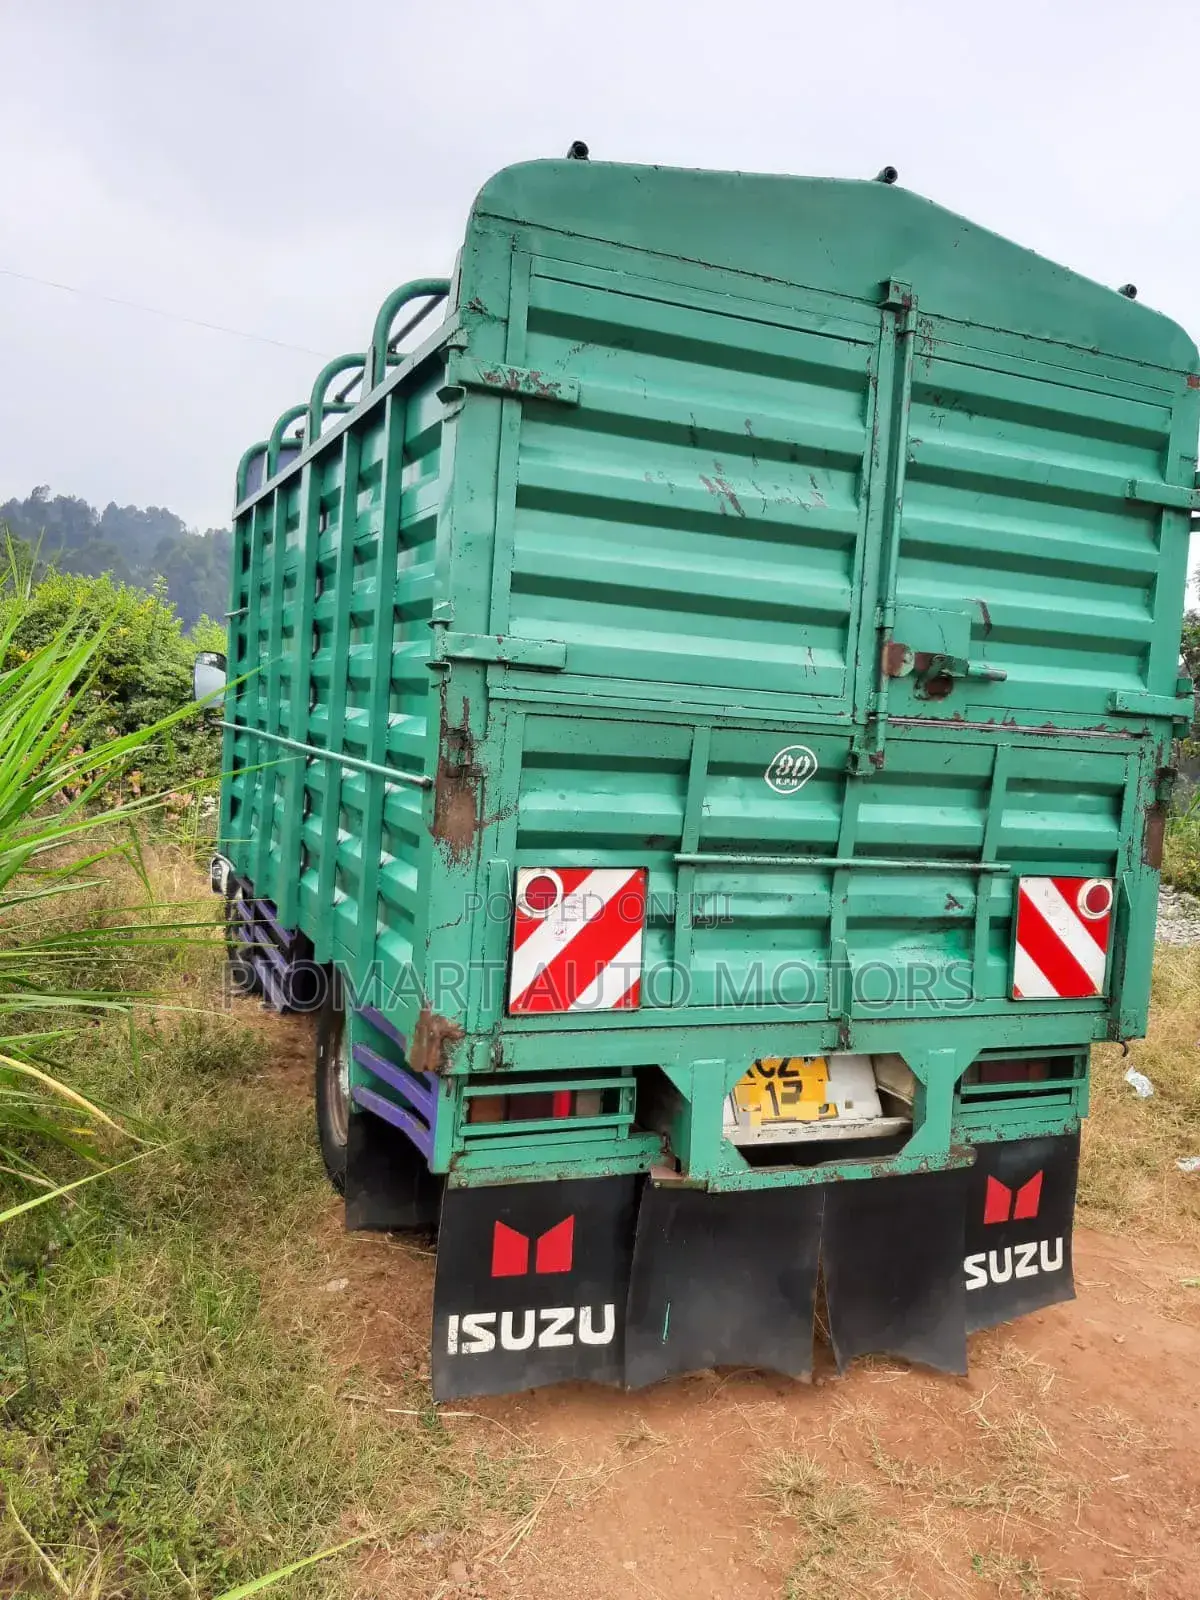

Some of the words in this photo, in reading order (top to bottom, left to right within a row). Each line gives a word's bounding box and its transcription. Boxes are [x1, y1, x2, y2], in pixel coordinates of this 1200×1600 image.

[747, 1057, 799, 1078] CZ
[963, 1237, 1064, 1291] SUZU
[447, 1303, 616, 1355] ISUZU
